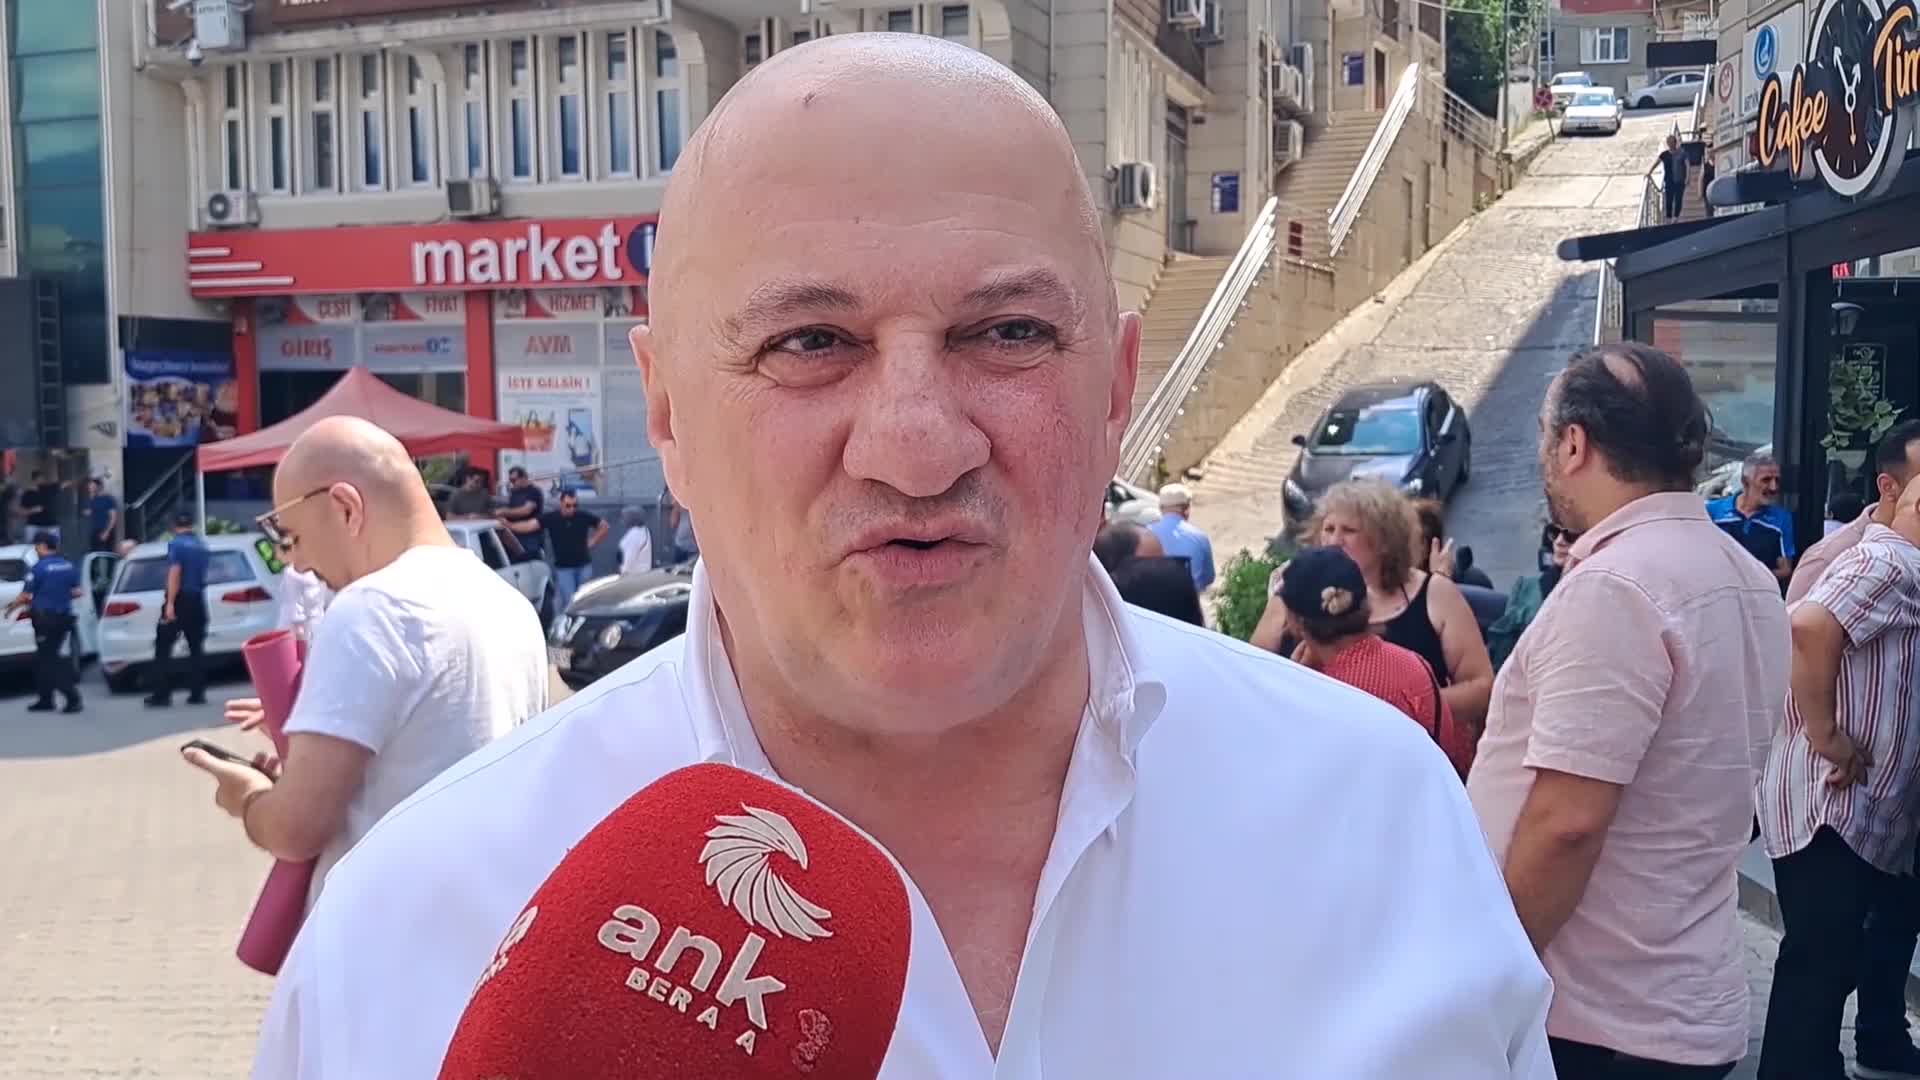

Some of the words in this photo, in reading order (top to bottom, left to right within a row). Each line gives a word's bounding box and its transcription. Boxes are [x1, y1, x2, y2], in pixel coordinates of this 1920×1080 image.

[1759, 70, 1829, 175] Cafee
[413, 221, 622, 284] market
[526, 335, 572, 353] AVM
[598, 904, 786, 1029] ank
